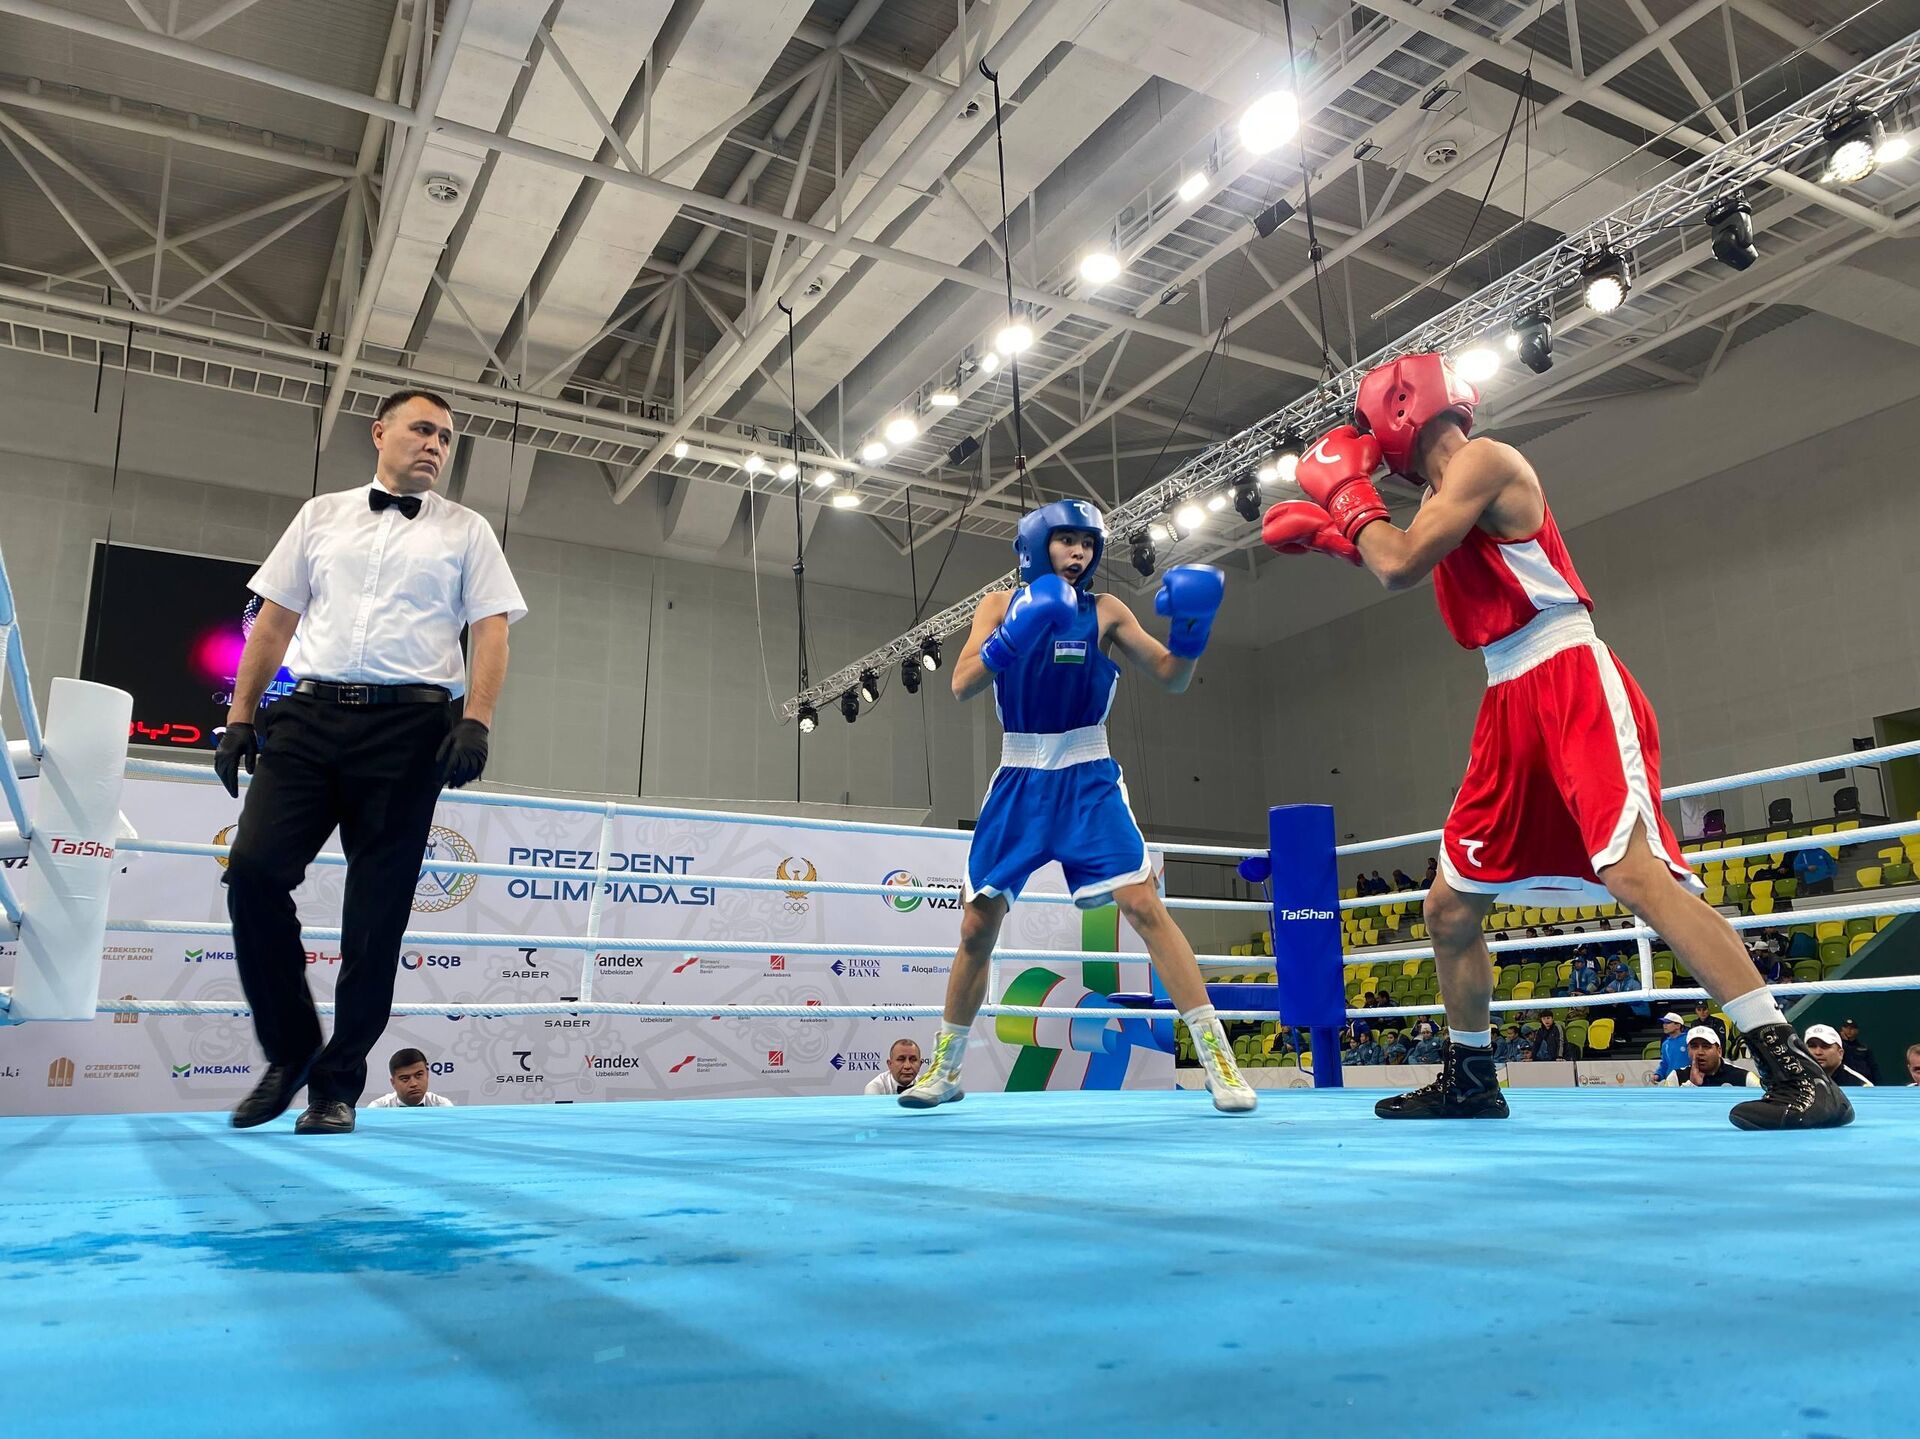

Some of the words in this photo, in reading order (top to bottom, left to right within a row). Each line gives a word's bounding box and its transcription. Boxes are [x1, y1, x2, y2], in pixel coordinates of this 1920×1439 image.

[1281, 909, 1334, 921] TaiShan
[426, 955, 462, 969] SQB
[848, 959, 880, 967] TURON
[502, 970, 550, 978] SABER
[848, 969, 880, 977] BANK
[544, 1020, 591, 1028] SABER
[847, 1052, 880, 1060] TURON
[585, 1055, 640, 1069] Yandex
[193, 1065, 251, 1074] MKBANK
[848, 1062, 880, 1071] BANK
[496, 1075, 544, 1083] SABER
